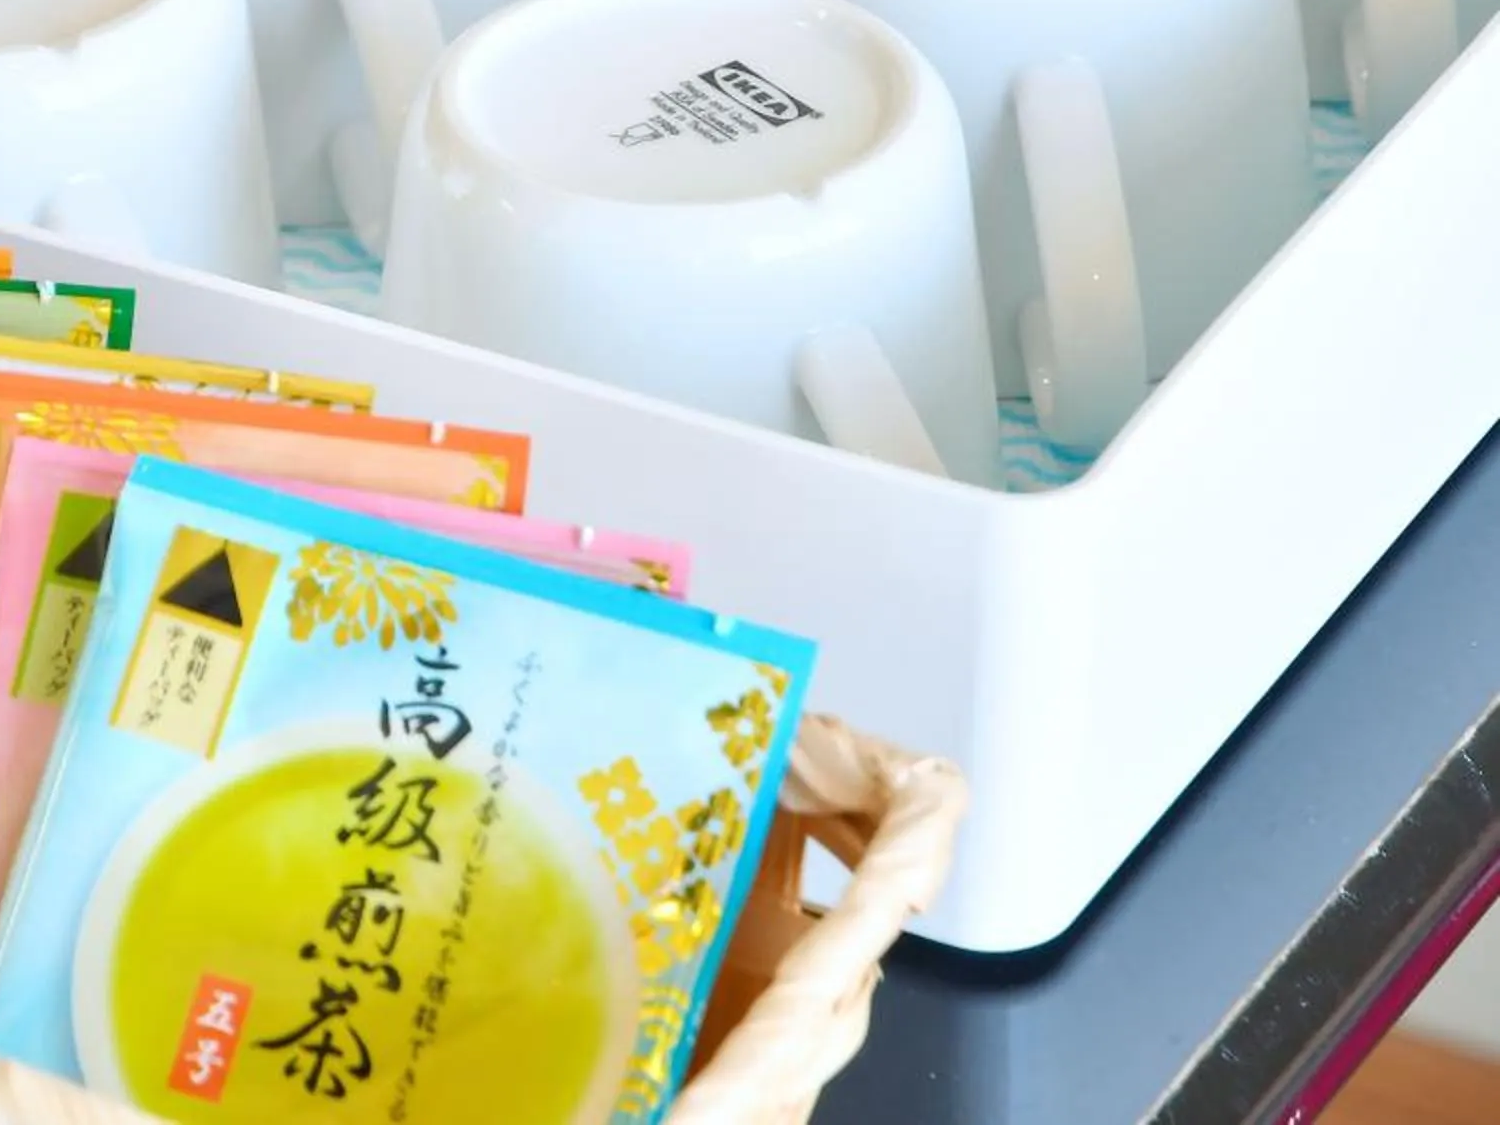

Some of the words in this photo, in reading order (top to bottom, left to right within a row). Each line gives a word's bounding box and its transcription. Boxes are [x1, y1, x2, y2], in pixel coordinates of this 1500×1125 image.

[177, 634, 215, 705] 便利な
[251, 645, 473, 1101] 高級煎茶
